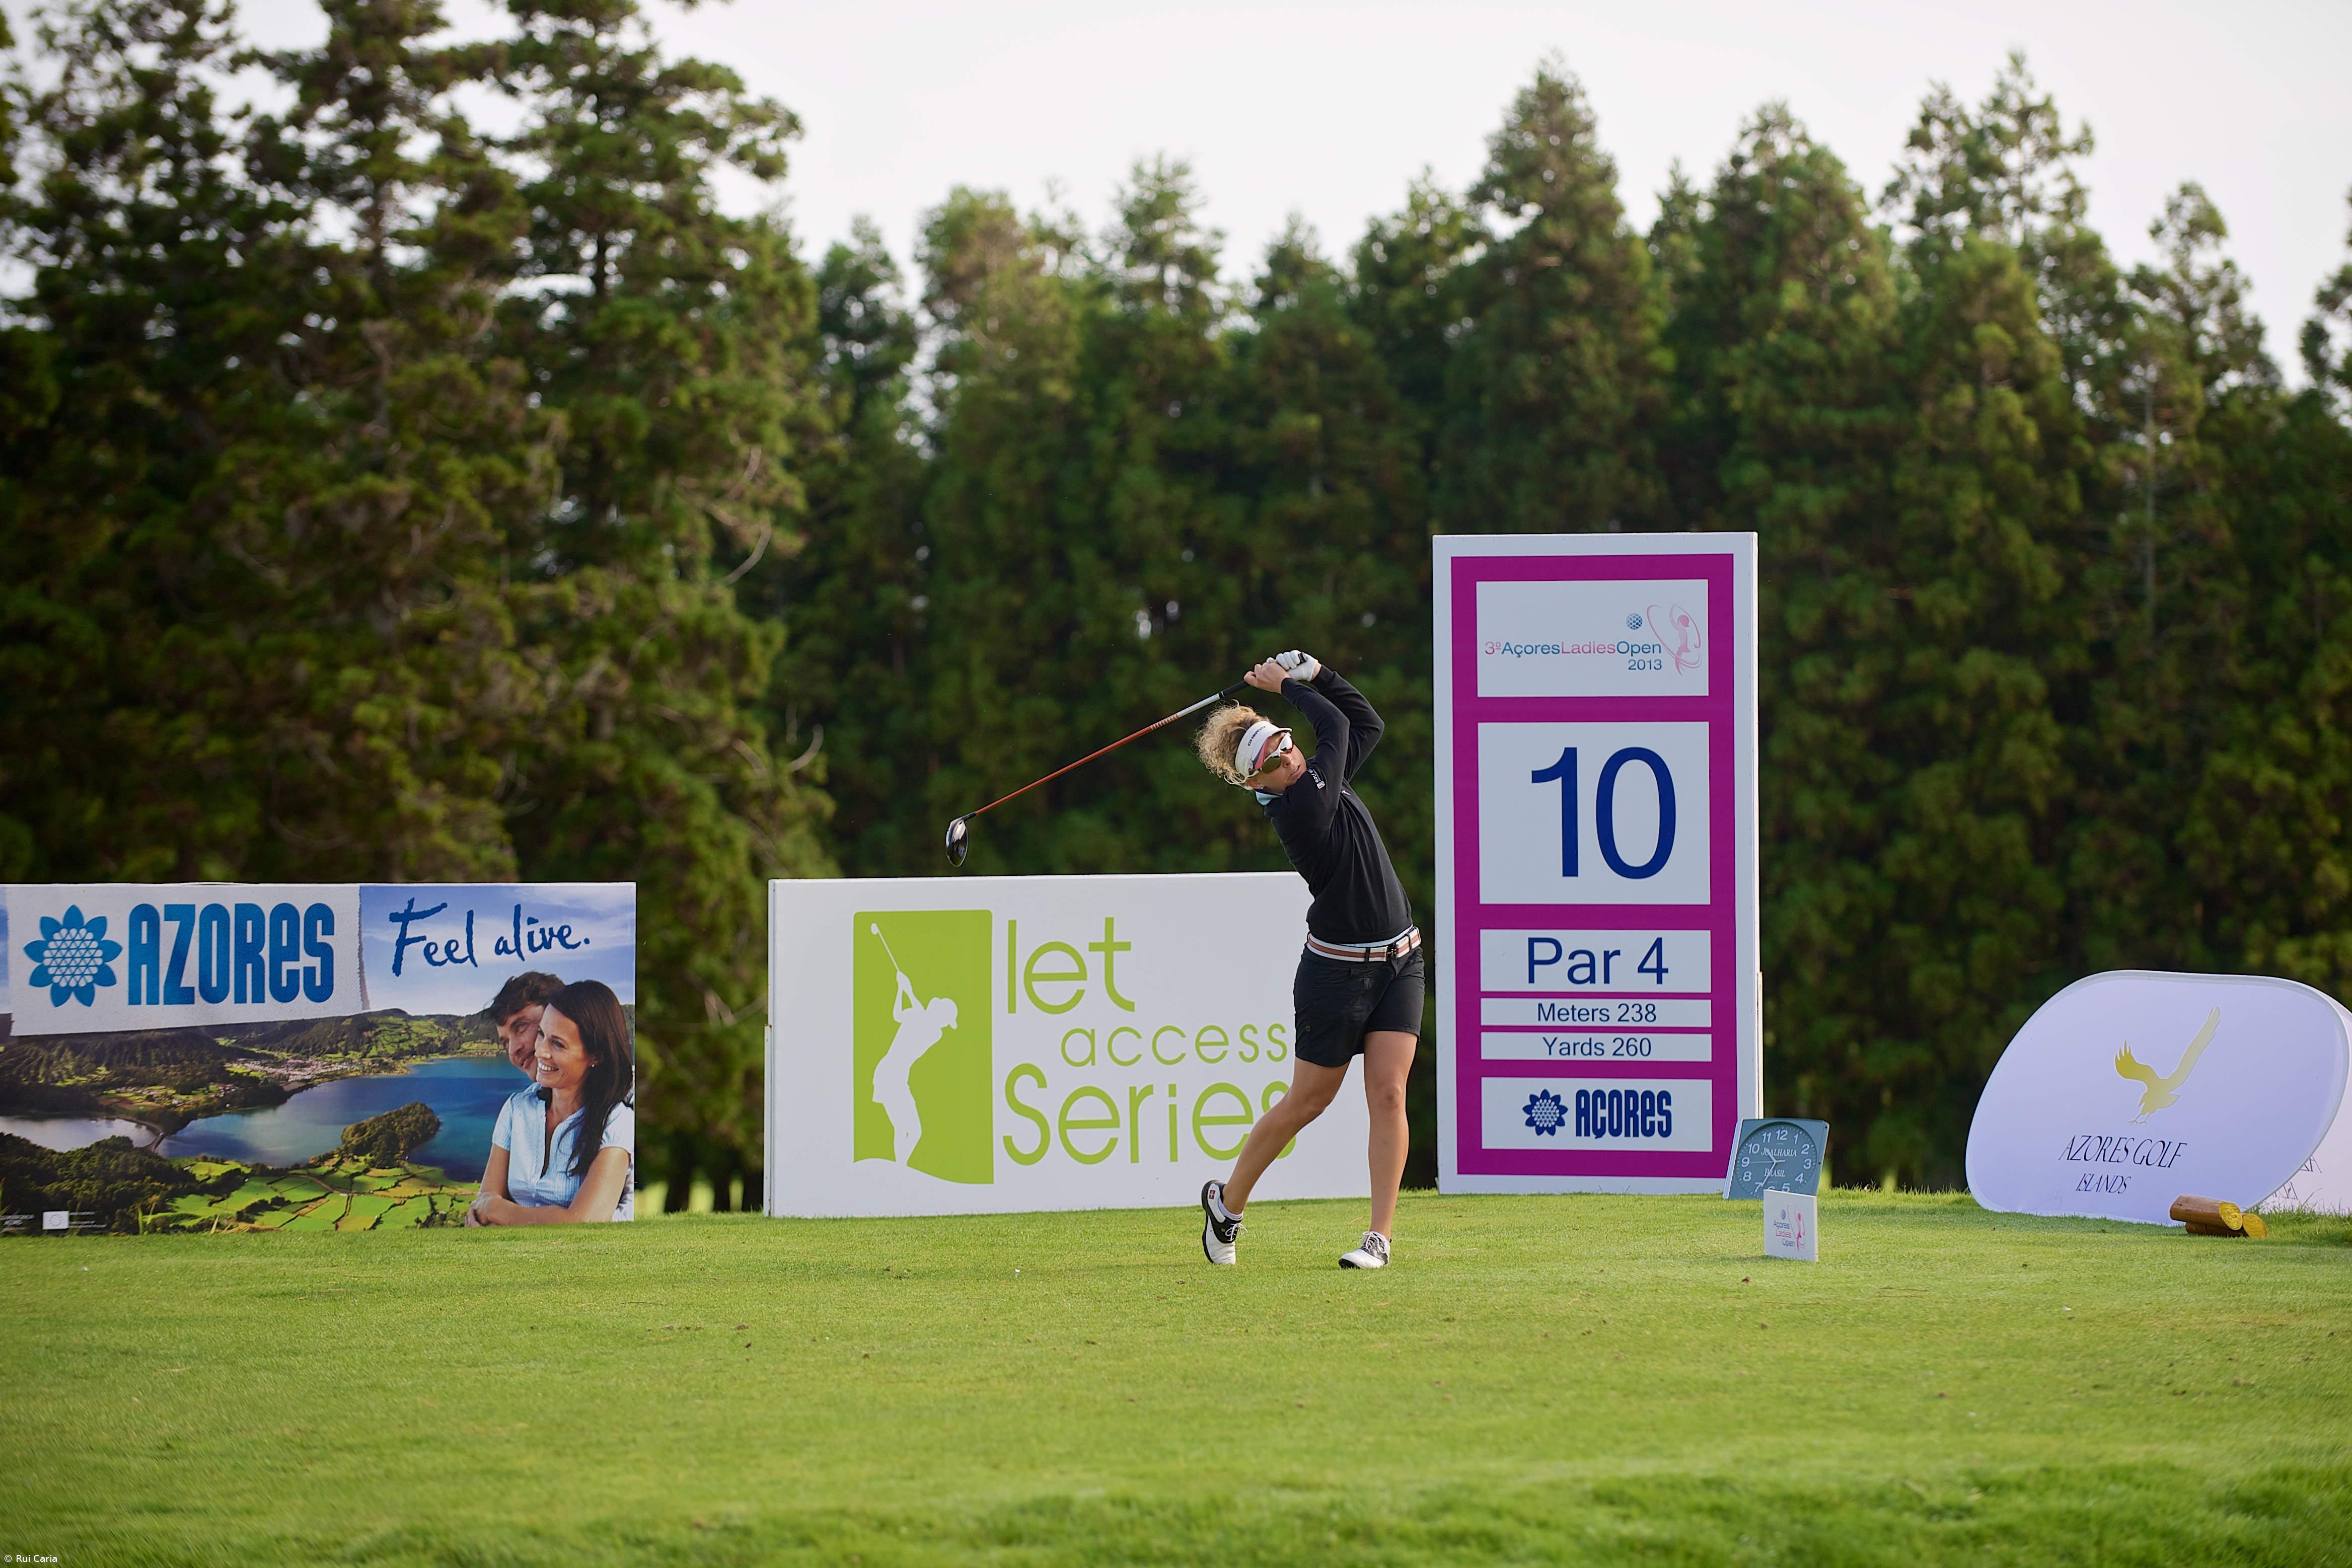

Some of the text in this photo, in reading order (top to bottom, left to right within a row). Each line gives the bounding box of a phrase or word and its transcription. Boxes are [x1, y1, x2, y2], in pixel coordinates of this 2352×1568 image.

[1628, 658, 1662, 670] 2013
[1531, 746, 1676, 880] 10
[389, 897, 591, 977] Feel alive.
[1007, 917, 1135, 1015] let
[1527, 937, 1669, 985] Par 4
[1537, 1003, 1657, 1023] Meters 238
[1060, 1023, 1288, 1067] access
[1542, 1037, 1652, 1057] Yards 260
[1762, 1132, 1772, 1143] 11
[1776, 1129, 1788, 1140] 12
[1794, 1134, 1799, 1145] 1
[1748, 1143, 1760, 1154] 10
[1761, 1147, 1797, 1157] JOALHARIA
[1801, 1143, 1810, 1155] 2
[2059, 1134, 2187, 1168] AZORES GOLF
[1741, 1156, 1750, 1168] 9
[1803, 1158, 1812, 1169] 3
[1743, 1171, 1752, 1182] 8
[1764, 1168, 1786, 1177] BRASIL
[1795, 1172, 1804, 1183] 4
[1754, 1182, 1763, 1193] 7
[1781, 1183, 1790, 1192] 5
[2075, 1173, 2132, 1194] ISLANDS
[1773, 1220, 1790, 1230] Açores
[1775, 1229, 1792, 1238] Ladies
[1782, 1238, 1796, 1247] Open
